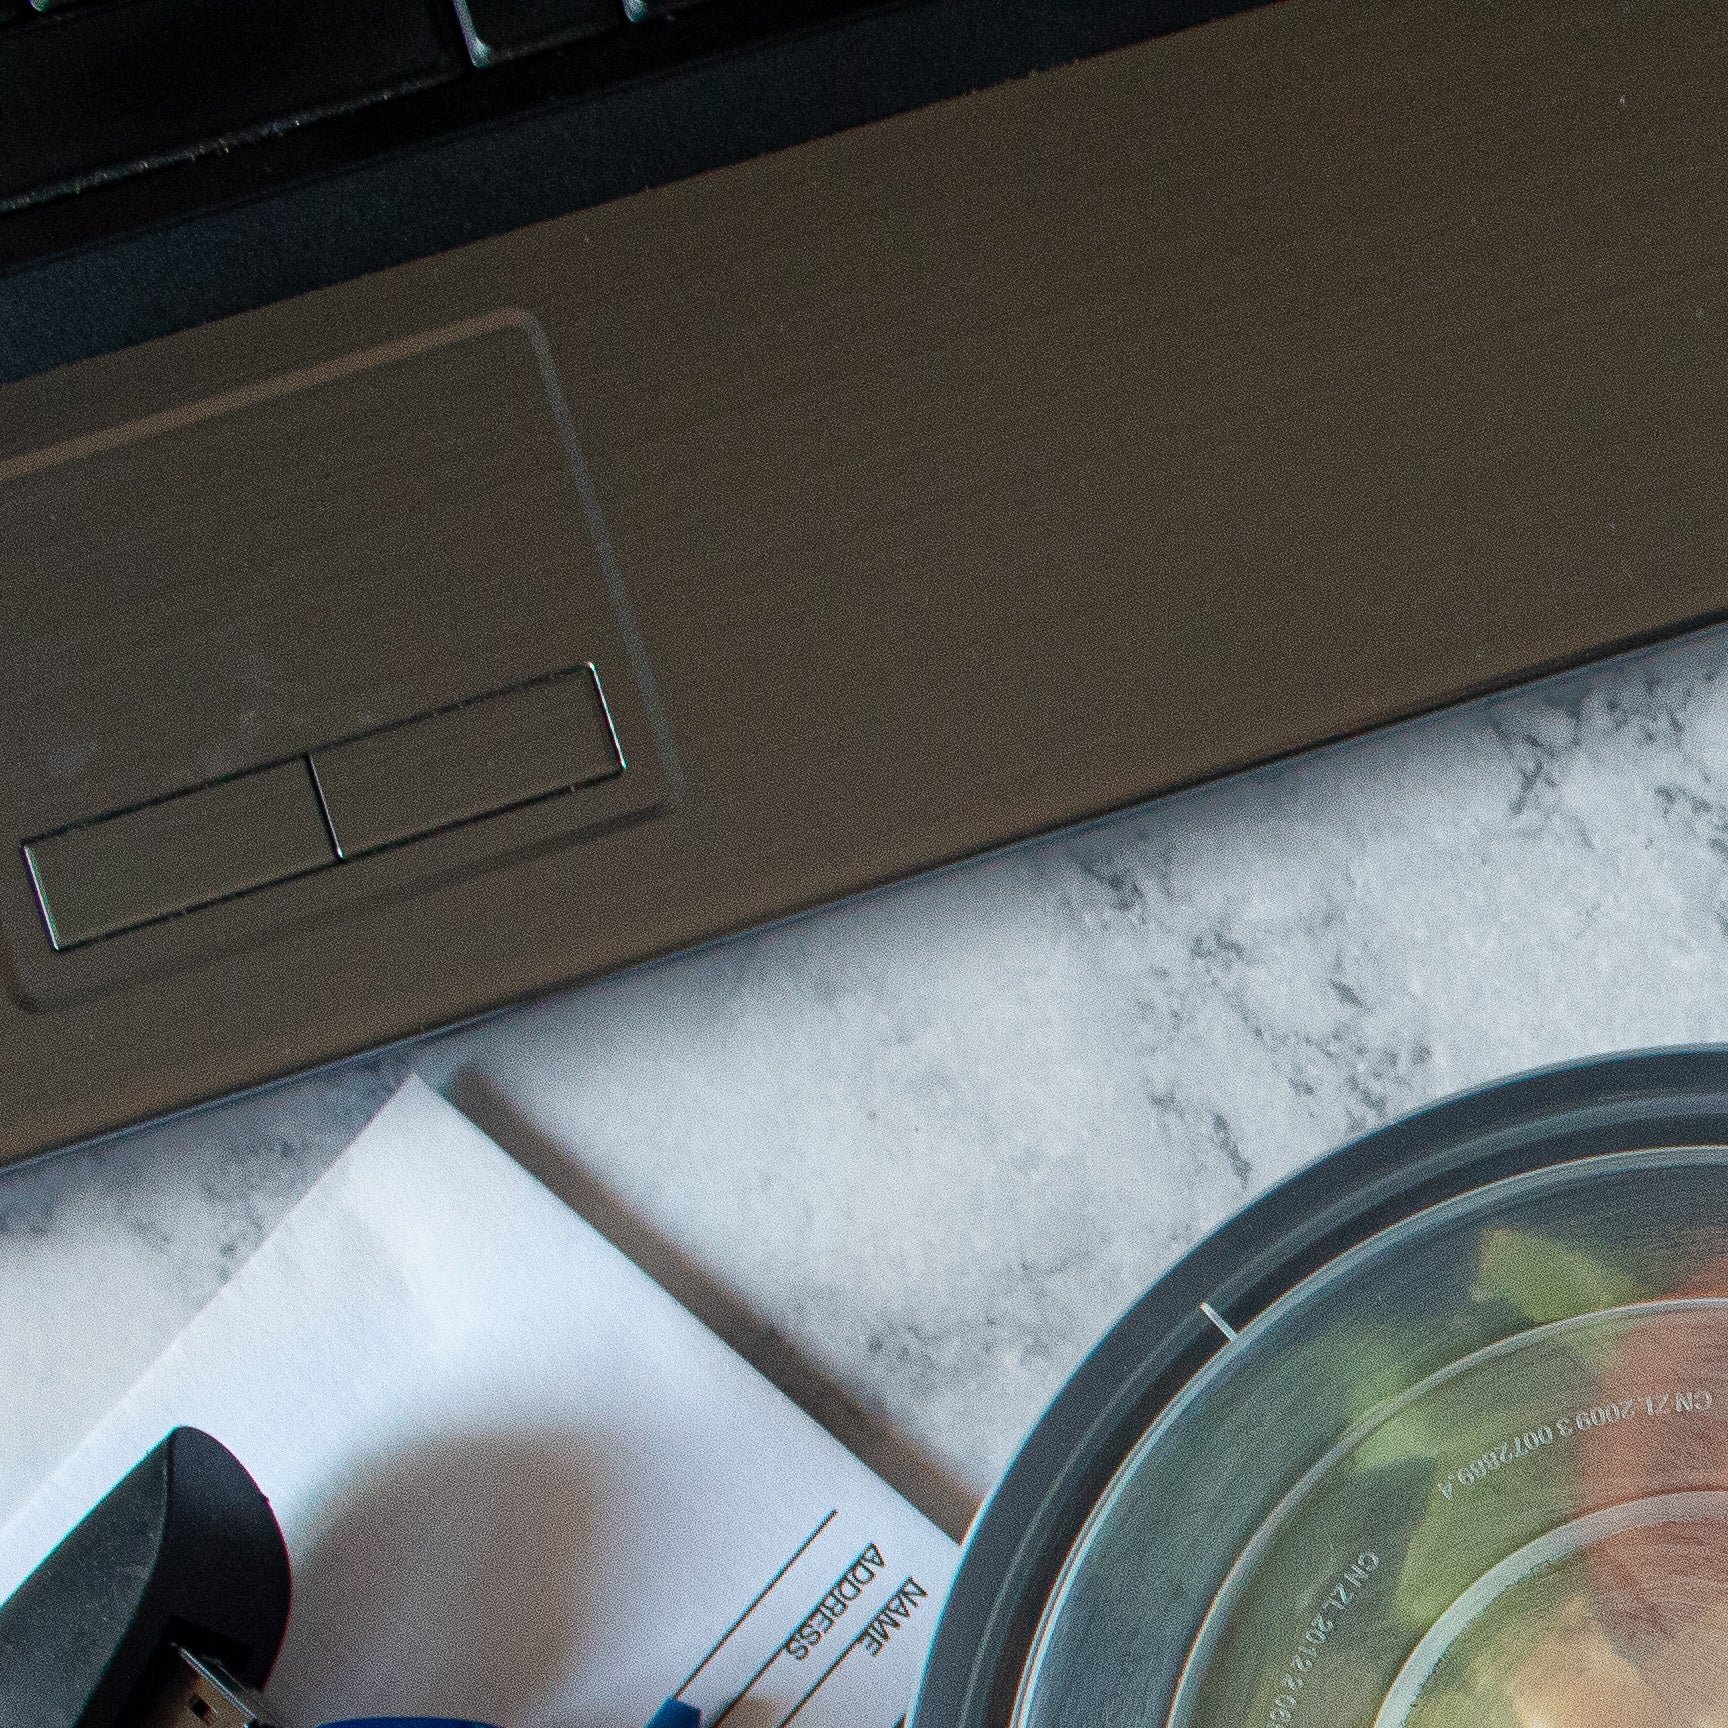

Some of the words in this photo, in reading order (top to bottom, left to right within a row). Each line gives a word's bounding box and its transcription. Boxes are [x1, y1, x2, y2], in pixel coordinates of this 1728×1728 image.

[1574, 1399, 1636, 1432] 2009
[1674, 1391, 1711, 1411] CN
[1556, 1417, 1575, 1438] 3
[1343, 1550, 1381, 1588] CN
[784, 1542, 886, 1660] ADDRESS
[1321, 1582, 1354, 1612] ZL
[862, 1577, 928, 1656] NAME
[1290, 1612, 1334, 1672] 2012
[1281, 1672, 1305, 1691] 2
